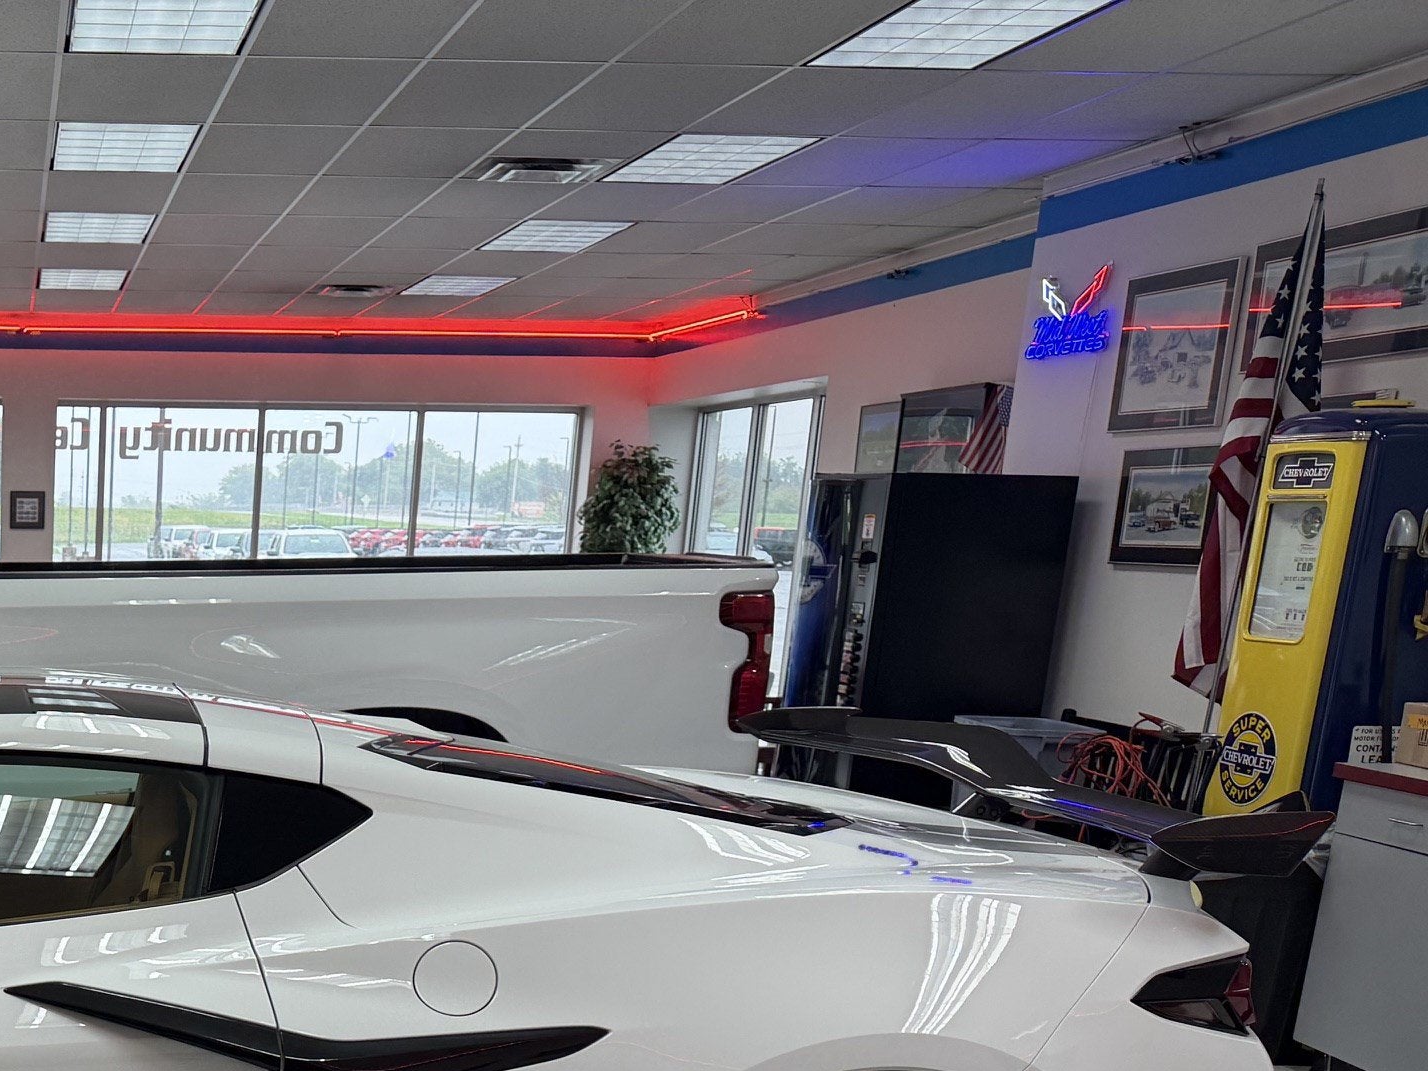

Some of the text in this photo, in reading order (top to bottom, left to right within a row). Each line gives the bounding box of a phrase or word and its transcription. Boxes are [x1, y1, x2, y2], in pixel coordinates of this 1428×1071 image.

[1025, 339, 1105, 359] CORVETTES
[1283, 467, 1328, 478] CHEVROLET
[1232, 716, 1271, 742] SUPER
[1223, 749, 1273, 770] CHEVROLET
[1221, 770, 1264, 800] SERVICE
